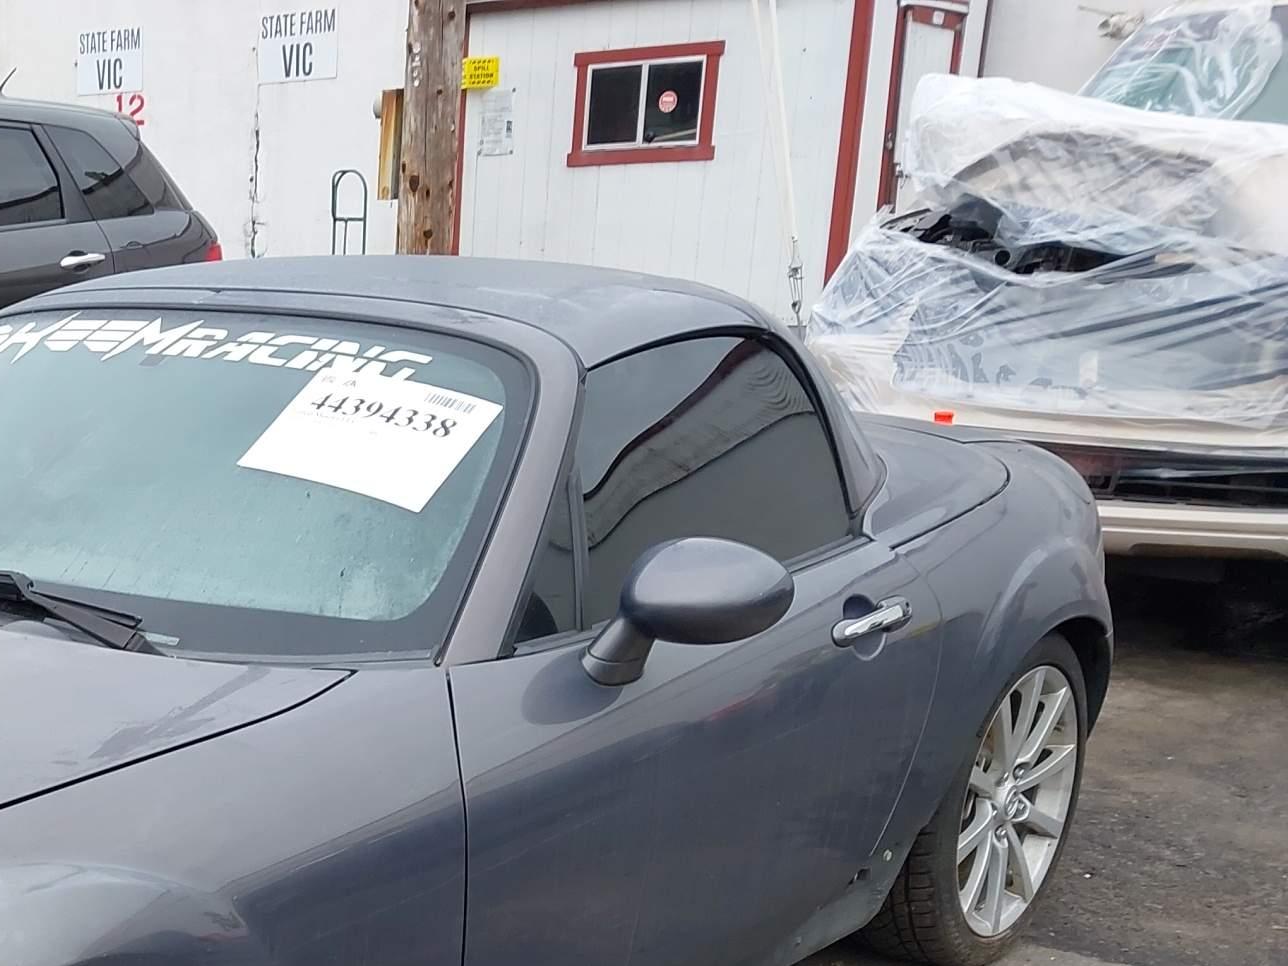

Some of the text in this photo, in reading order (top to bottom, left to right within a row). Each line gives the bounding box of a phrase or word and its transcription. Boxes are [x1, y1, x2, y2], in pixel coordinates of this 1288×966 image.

[261, 8, 336, 39] STATE FARM
[79, 27, 141, 54] STATE FARM
[96, 58, 123, 90] VIC
[282, 42, 313, 78] VIC
[116, 92, 145, 125] 12
[311, 393, 458, 438] 44394338
